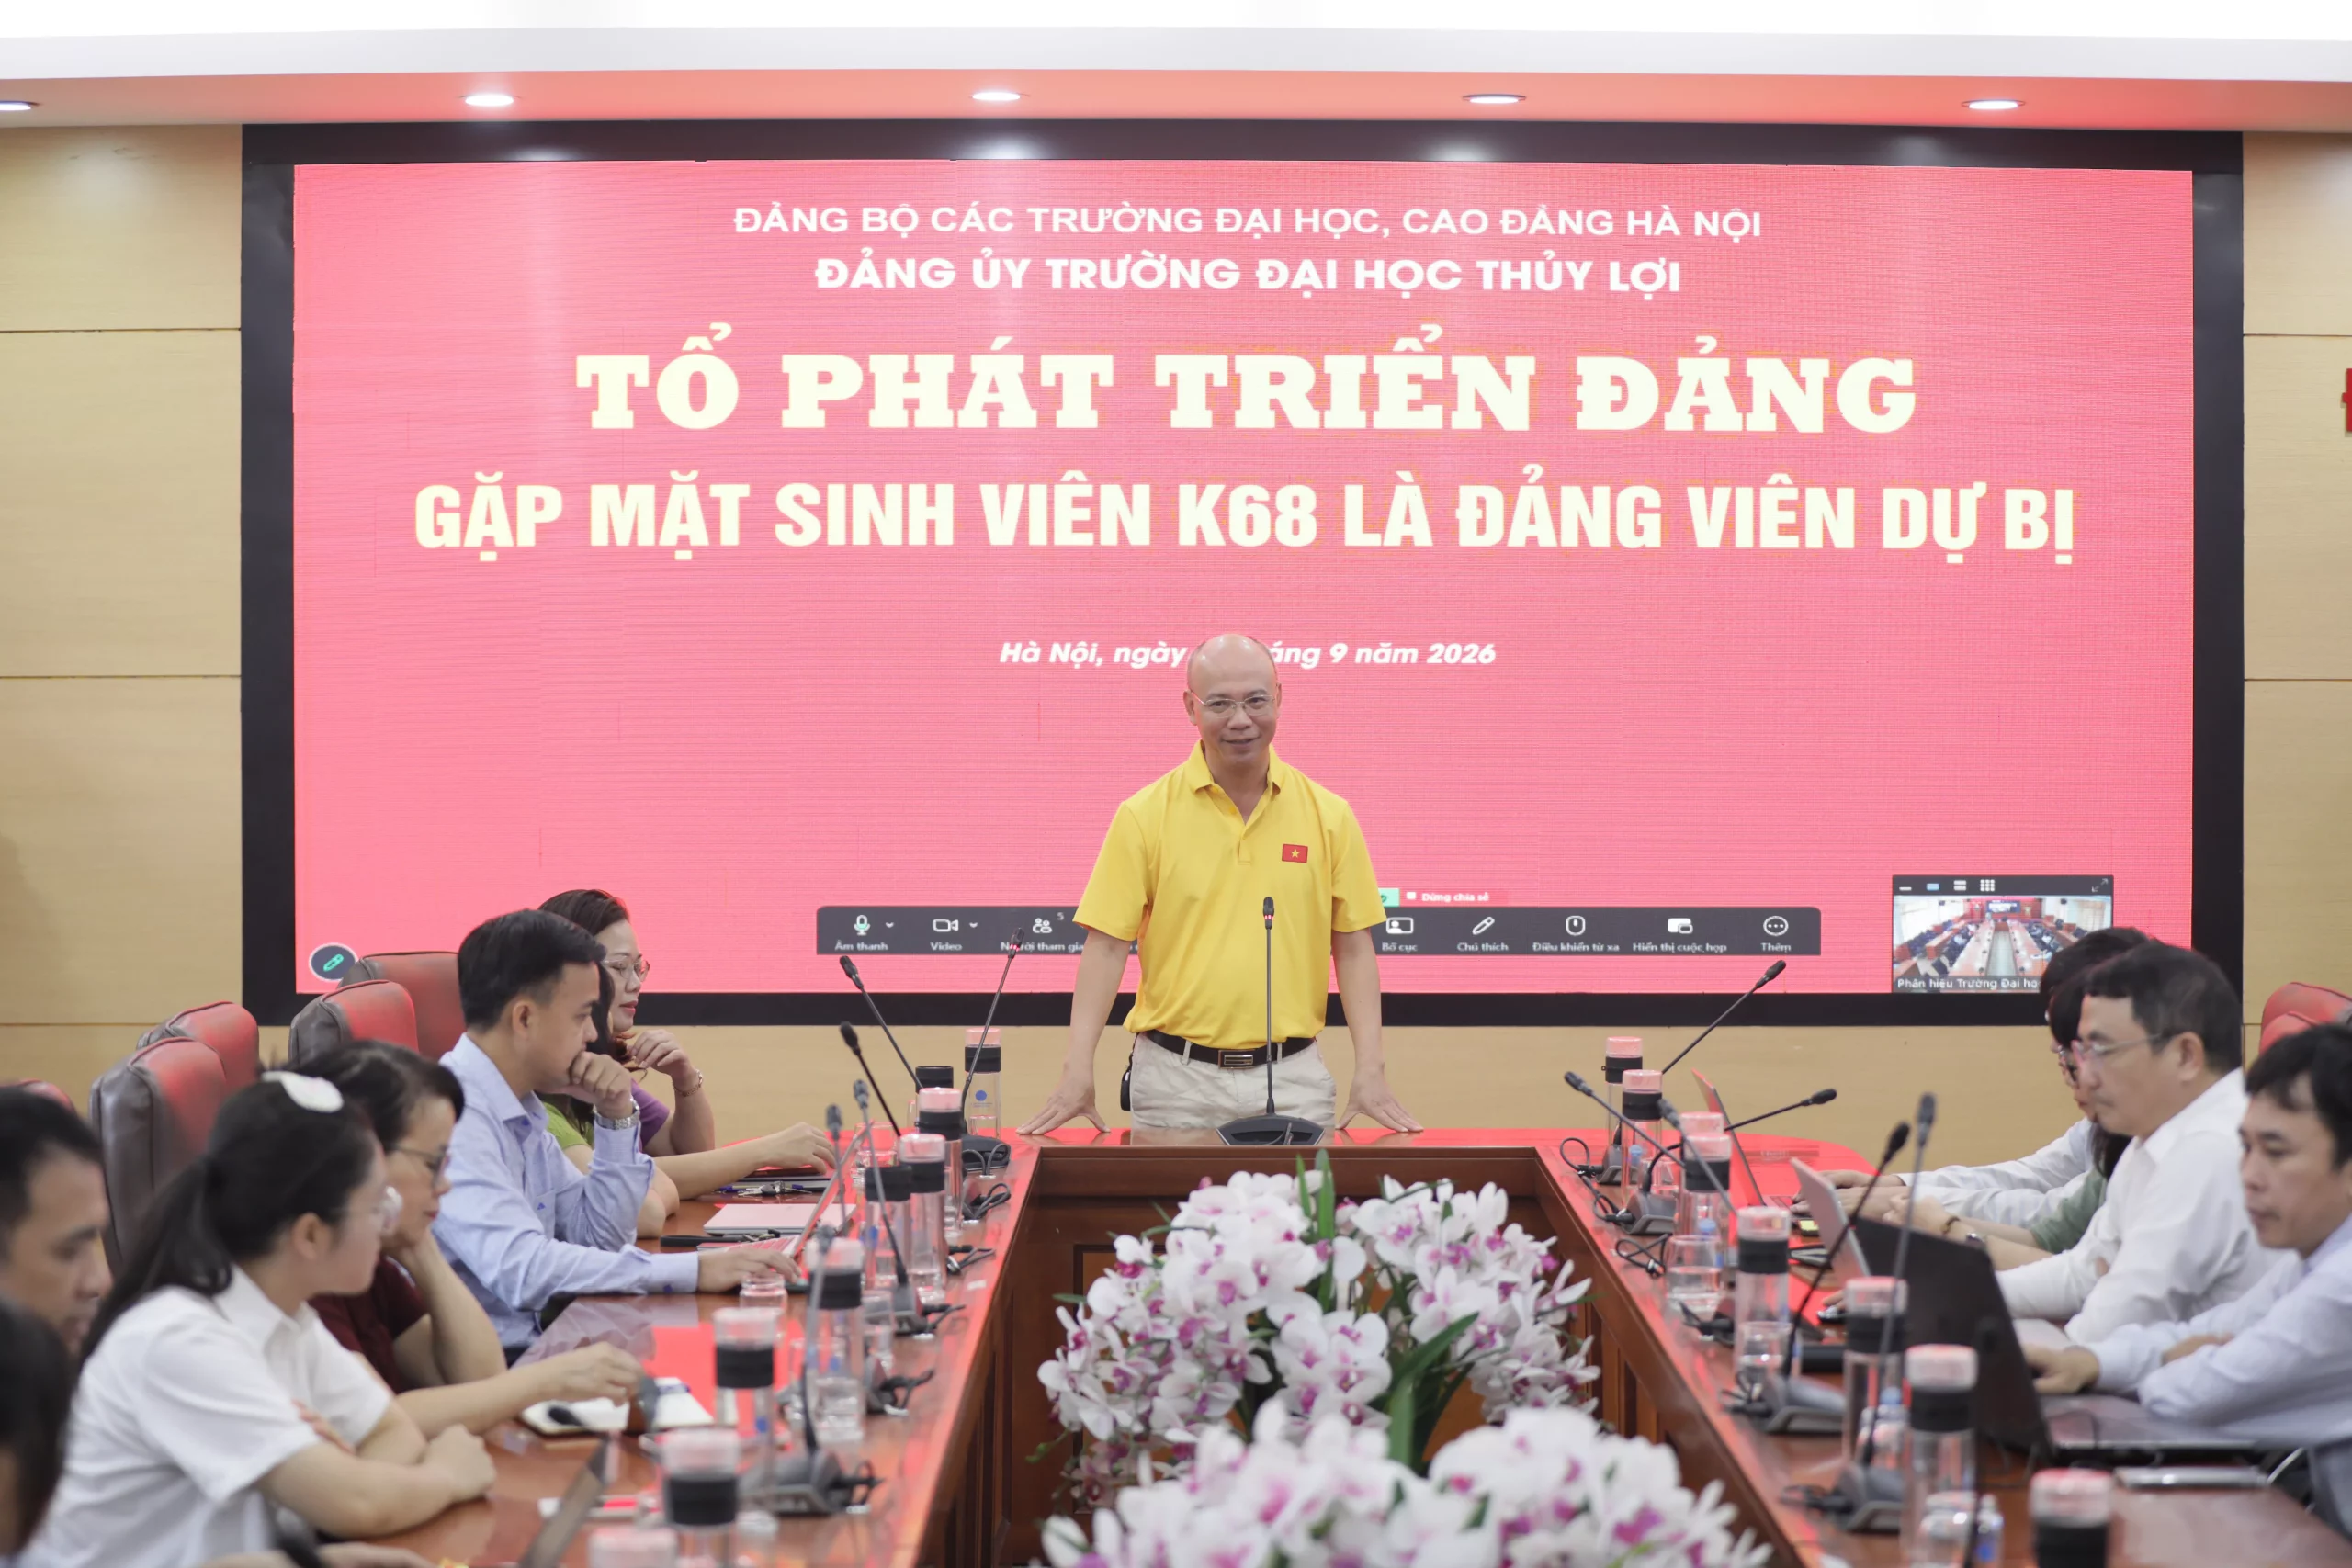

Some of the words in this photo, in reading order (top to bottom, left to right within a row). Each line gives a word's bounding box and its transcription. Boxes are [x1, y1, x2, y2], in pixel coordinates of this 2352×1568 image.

[733, 201, 848, 233] ĐẢNG
[862, 204, 919, 239] BỘ
[931, 201, 1014, 233] CÁC
[1027, 201, 1204, 233] TRƯỜNG
[1215, 207, 1281, 242] ĐẠI
[1295, 207, 1390, 242] HỌC,
[1403, 209, 1488, 235] CAO
[1627, 205, 1681, 236] HÀ
[1694, 208, 1761, 243] NỘI
[814, 247, 956, 289] ĐẢNG
[971, 247, 1032, 289] ỦY
[1045, 249, 1241, 289] TRƯỜNG
[1255, 259, 1337, 299] ĐẠI
[1355, 259, 1463, 299] HỌC
[1476, 249, 1594, 291] THỦY
[1610, 257, 1680, 301] LỢI
[576, 321, 740, 430] TỔ
[781, 335, 1114, 429] PHÁT
[1154, 322, 1537, 432] TRIỂN
[1575, 334, 1917, 434] ĐẢNG
[414, 471, 563, 562] GẶP
[590, 470, 751, 561] MẶT
[775, 482, 955, 547] SINH
[979, 469, 1151, 547] VIÊN
[1178, 482, 1318, 547] K68
[1344, 470, 1433, 547] LÀ
[1455, 463, 1662, 549] ĐẢNG
[1687, 472, 1855, 549] VIÊN
[1882, 481, 1988, 564] DỰ
[2005, 488, 2075, 565] BỊ
[1000, 641, 1042, 664] Hà
[1048, 641, 1103, 670] Nội,
[1113, 641, 1188, 670] ngày
[1269, 640, 1321, 670] áng
[1329, 642, 1349, 663] 9
[1354, 642, 1419, 665] năm
[1426, 642, 1497, 665] 2026
[834, 939, 854, 952] Âm
[856, 941, 889, 952] thanh
[929, 941, 963, 952] Video
[1037, 942, 1066, 952] tham
[1480, 942, 1510, 953] thích
[1606, 943, 1621, 953] xa
